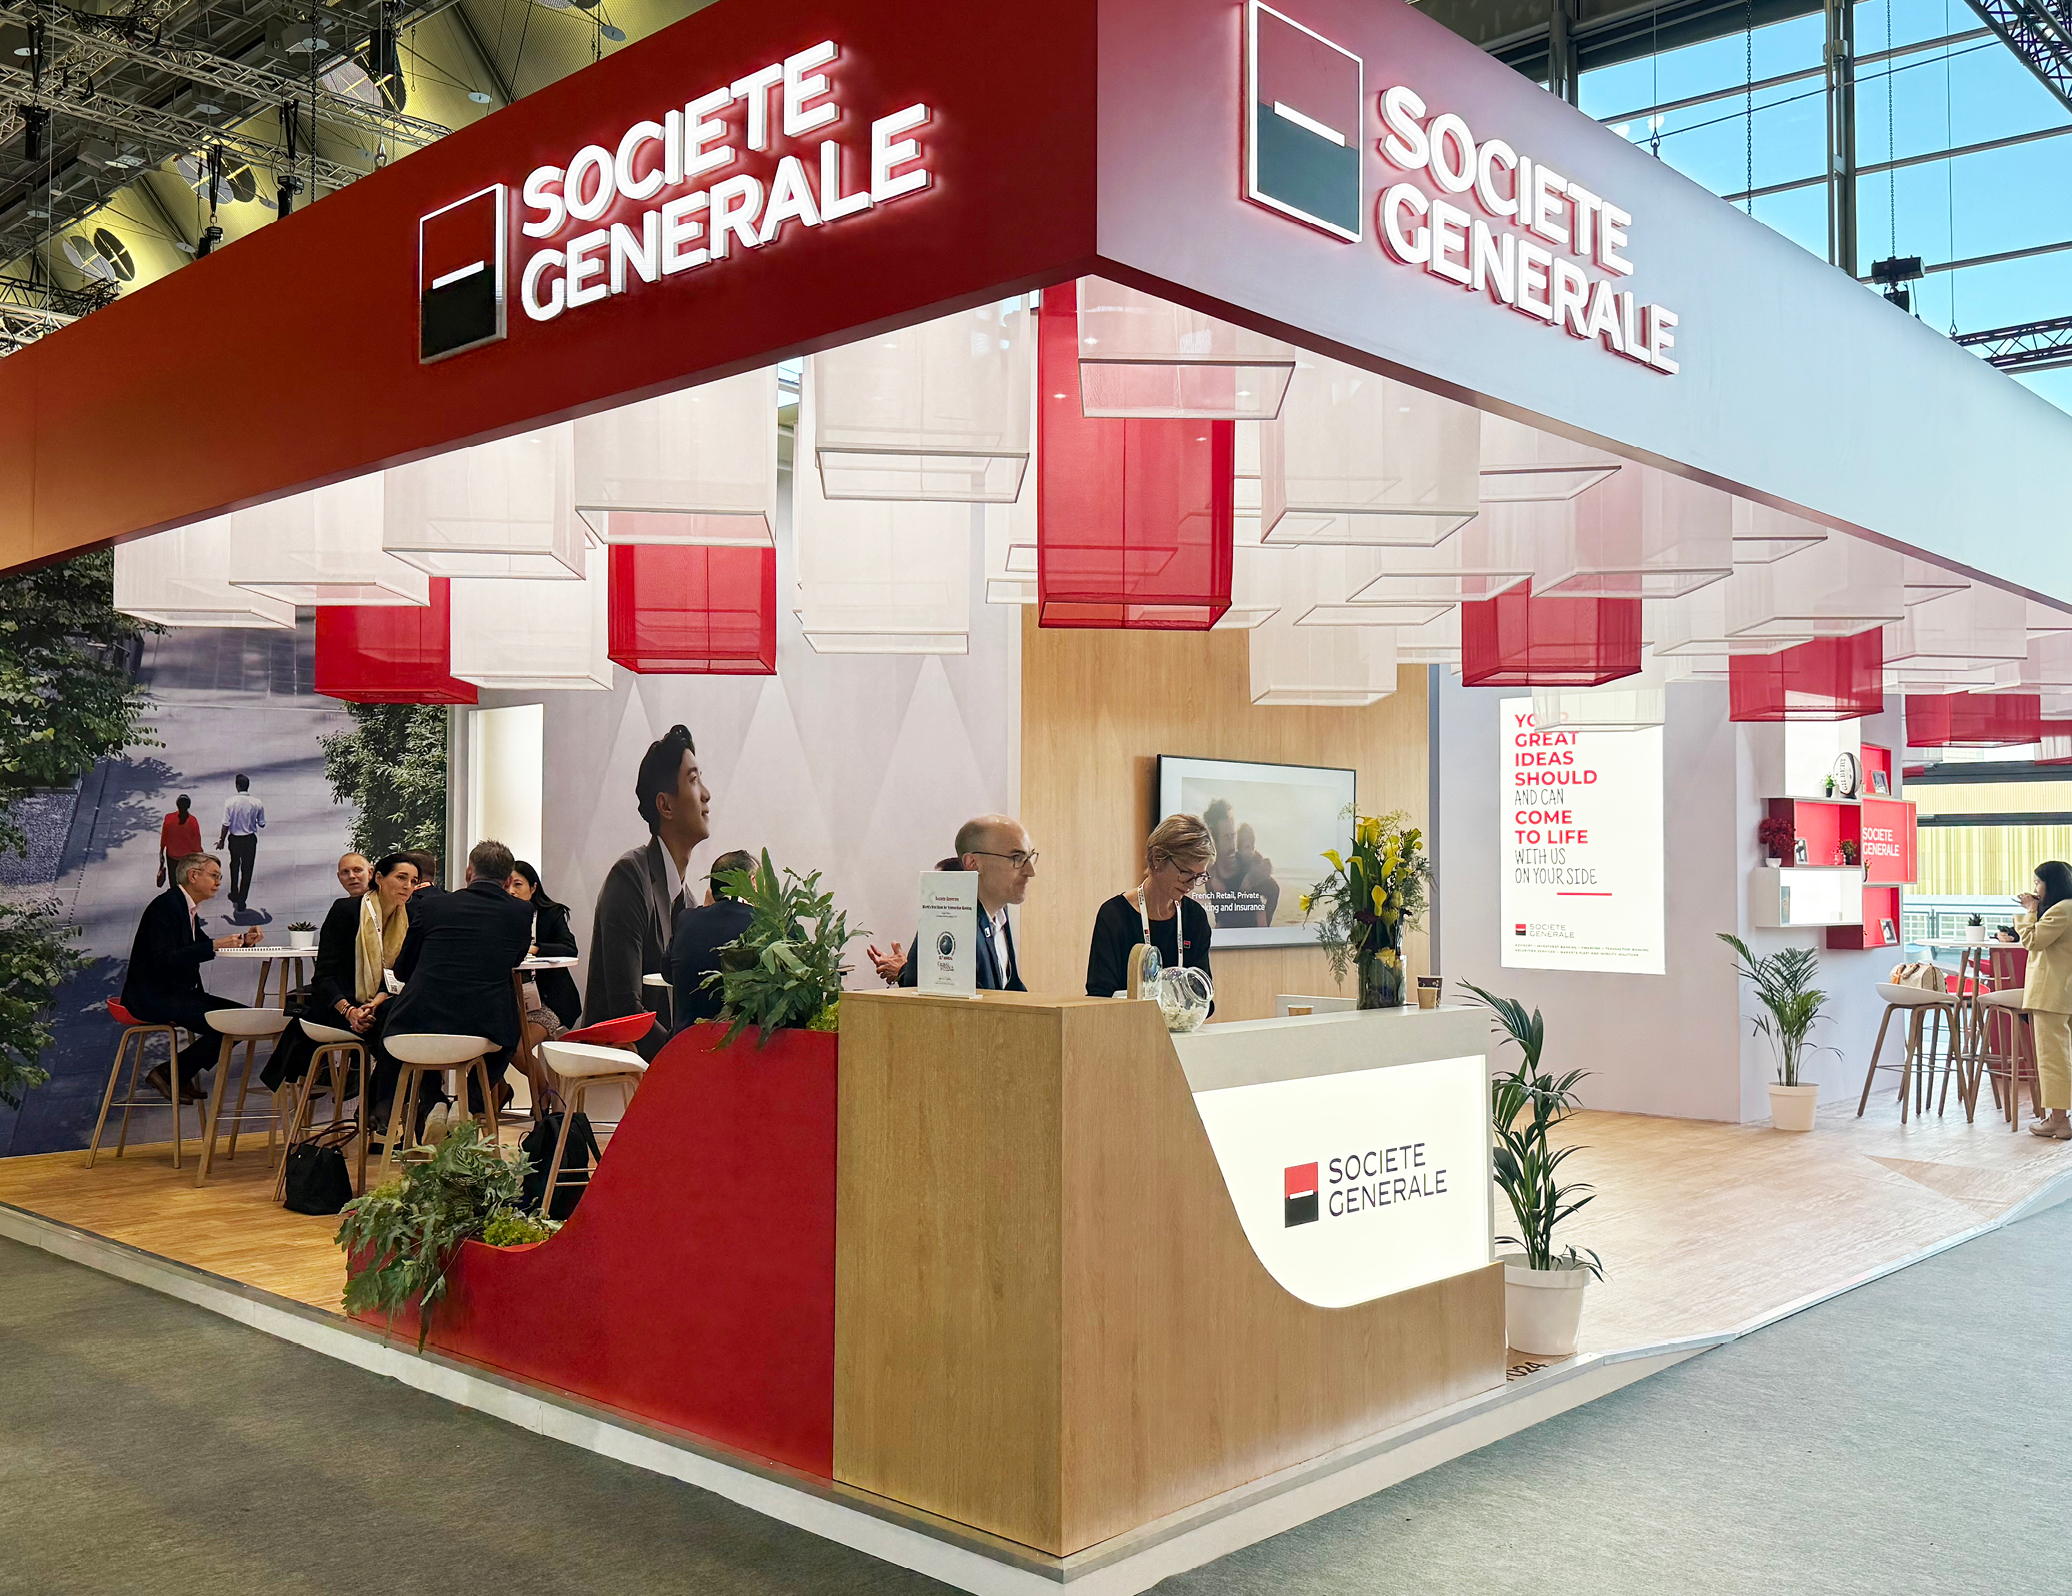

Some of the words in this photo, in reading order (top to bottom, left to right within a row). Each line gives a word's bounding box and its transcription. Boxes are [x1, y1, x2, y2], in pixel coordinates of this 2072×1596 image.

[522, 40, 838, 238] SOCIETE
[1380, 85, 1633, 276] SOCIETE
[521, 103, 931, 322] GENERALE
[1379, 183, 1679, 375] GENERALE
[1515, 731, 1579, 747] GREAT
[1515, 751, 1574, 767] IDEAS
[1515, 770, 1598, 786] SHOULD
[1514, 789, 1537, 805] AND
[1541, 788, 1564, 805] CAN
[1515, 810, 1573, 824] COME
[1515, 830, 1541, 844] TO
[1547, 830, 1588, 844] LIFE
[1862, 827, 1893, 842] SOCIETE
[1514, 848, 1547, 865] WITH
[1550, 848, 1566, 865] US
[1862, 841, 1900, 857] GENERALE
[1514, 868, 1530, 884] ON
[1533, 867, 1564, 885] YOUR
[1566, 868, 1598, 885] SIDE
[1191, 892, 1215, 900] French
[1216, 891, 1236, 901] Retail,
[1237, 891, 1260, 900] Private
[1220, 902, 1233, 912] and
[1234, 903, 1266, 912] Insurance
[1529, 923, 1566, 931] SOCIETE
[1529, 931, 1575, 939] GENERALE
[1329, 1142, 1426, 1184] SOCIETE
[1329, 1169, 1447, 1217] GENERALE
